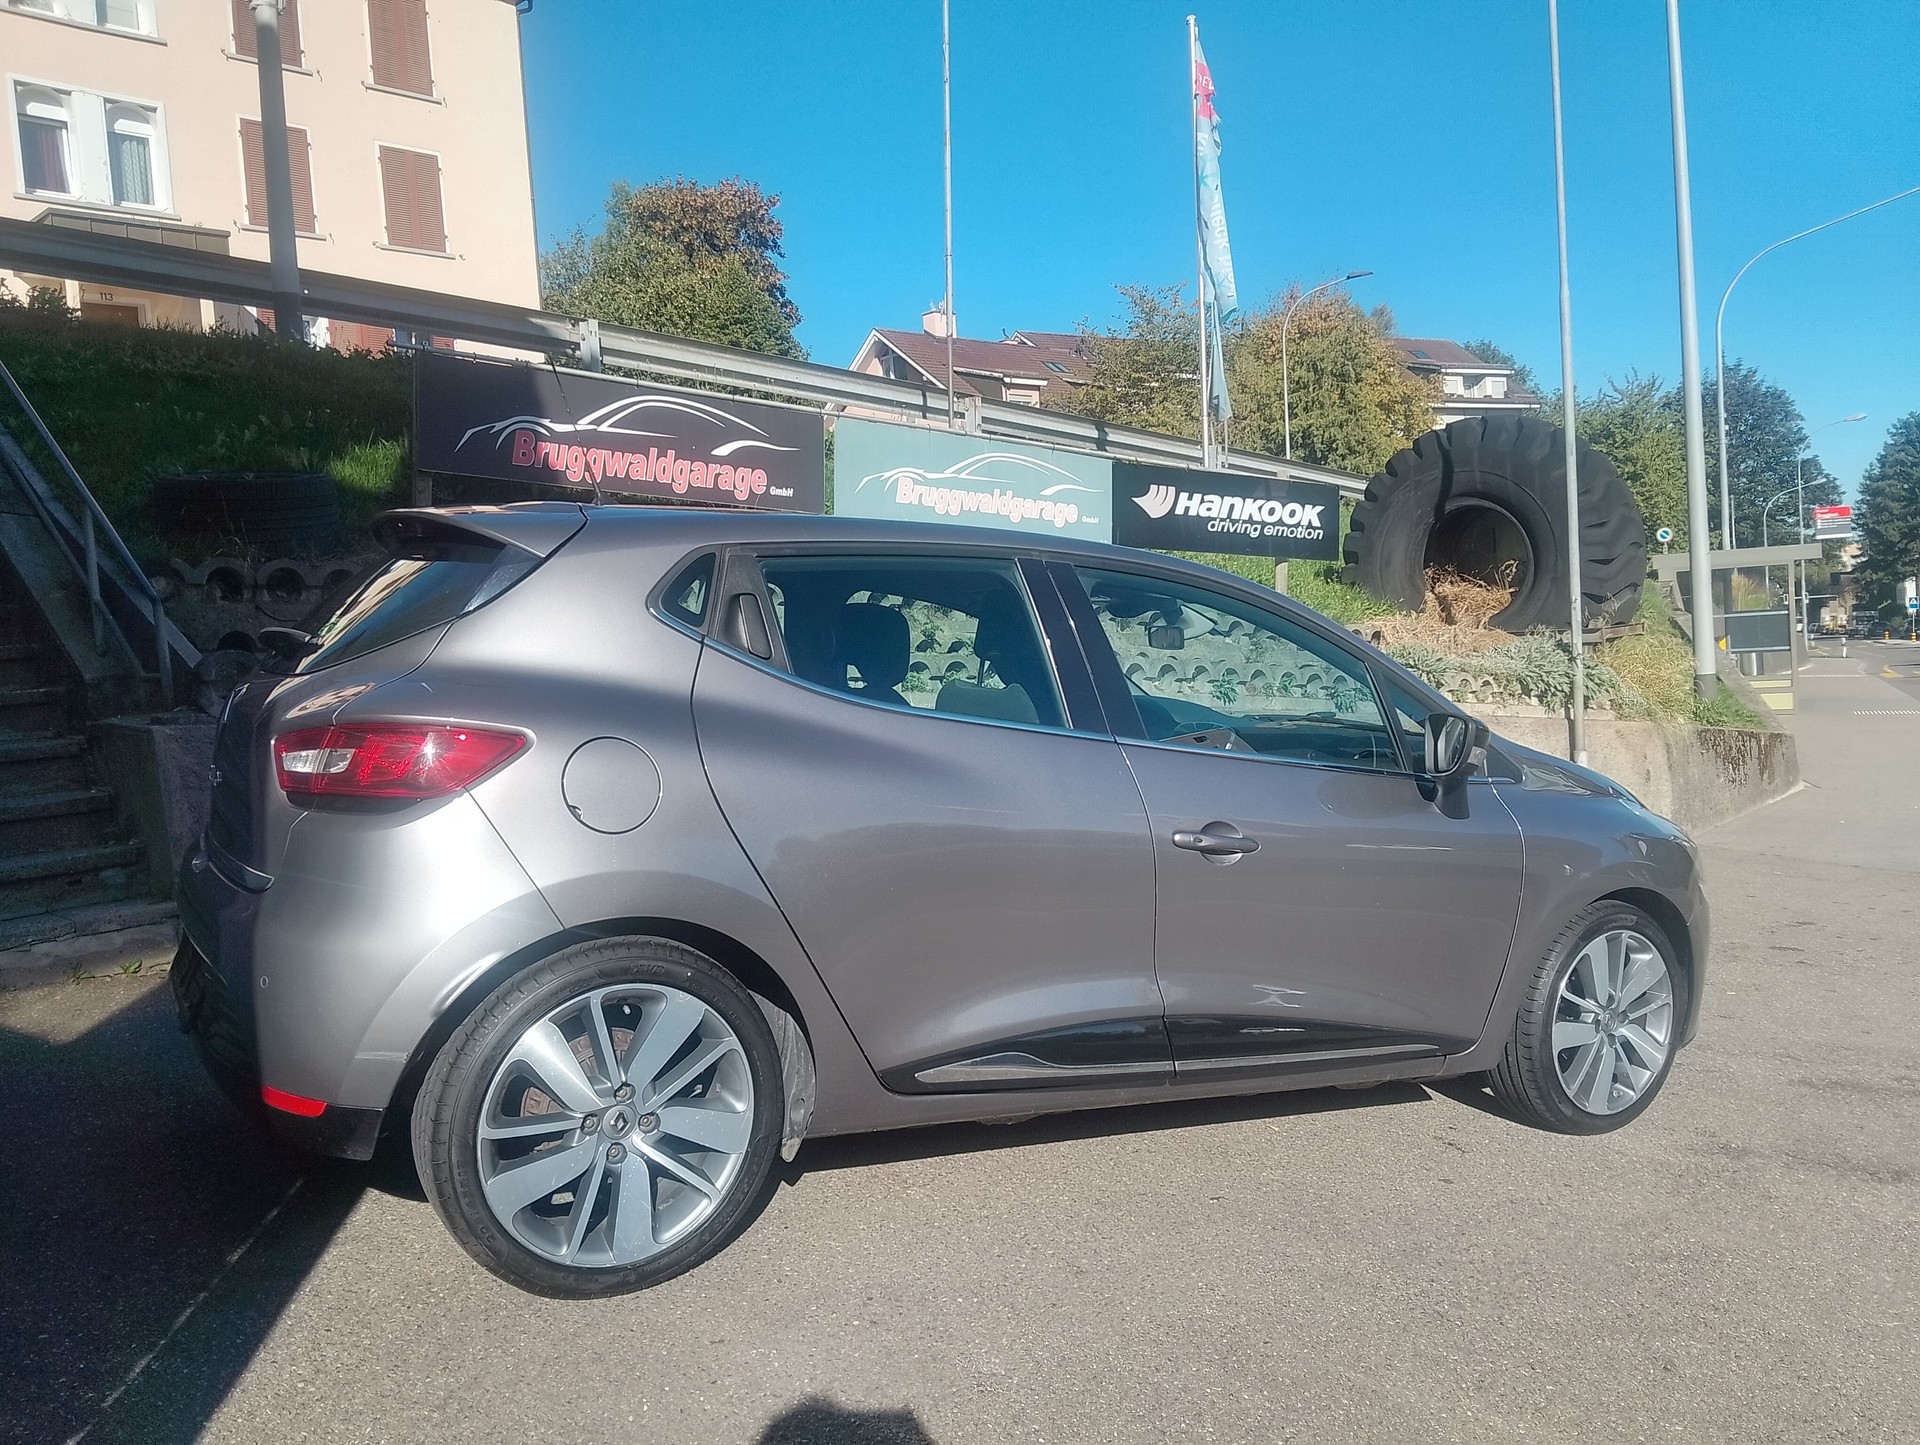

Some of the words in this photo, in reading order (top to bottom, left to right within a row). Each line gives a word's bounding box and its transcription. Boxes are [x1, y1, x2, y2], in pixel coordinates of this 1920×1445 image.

[99, 292, 114, 301] 113
[512, 430, 769, 501] Bruggwaldgarage
[770, 486, 794, 498] GmbH
[895, 476, 1079, 527] Bruggwaldgarage
[1207, 517, 1260, 539] driving
[1263, 525, 1324, 540] emotion
